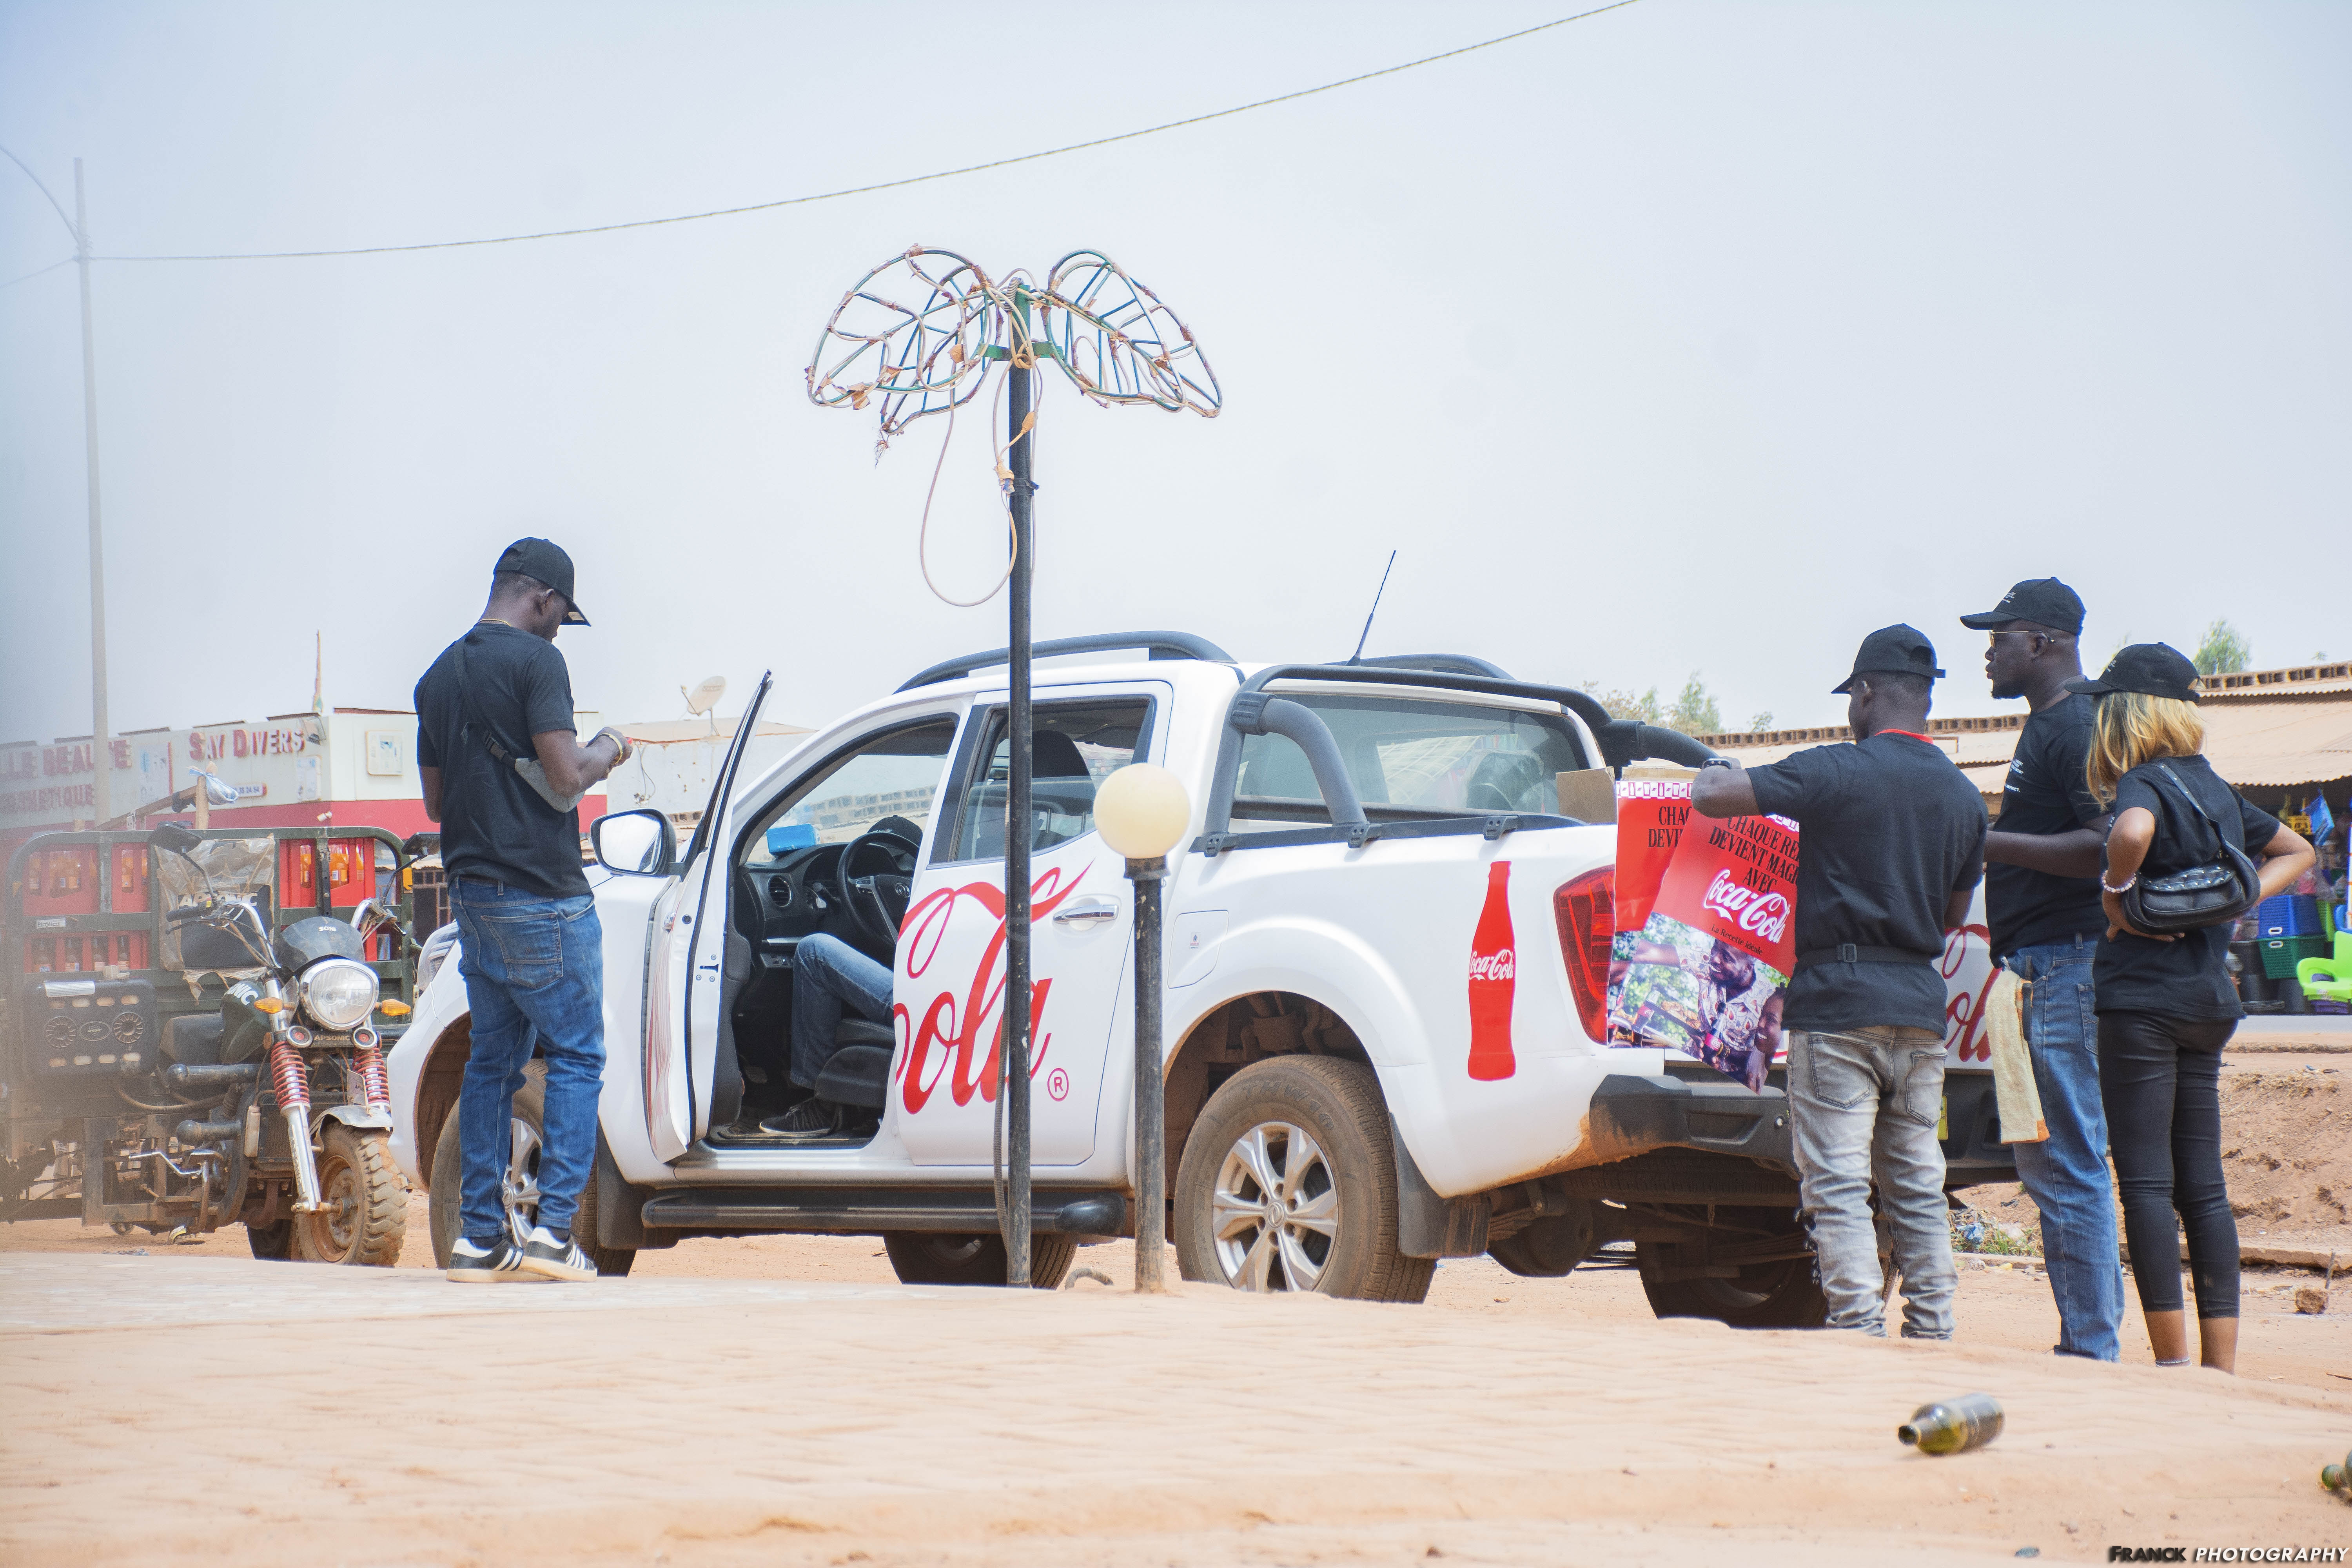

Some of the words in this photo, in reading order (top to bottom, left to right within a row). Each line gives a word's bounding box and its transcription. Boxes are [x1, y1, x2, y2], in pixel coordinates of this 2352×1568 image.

[43, 740, 132, 776] BEAUE
[189, 731, 225, 760] SAY
[233, 728, 306, 757] DIVERS
[1648, 828, 1684, 848] DEVI
[1709, 826, 1769, 867] DEVIENT
[1727, 816, 1782, 850] CHAQUE
[1779, 835, 1799, 862] RE
[1742, 866, 1778, 895] AVEC
[1711, 924, 1719, 933] La
[1720, 928, 1744, 946] Recette
[1745, 941, 1763, 956] Idéale
[1469, 949, 1514, 980] Coca-Cola
